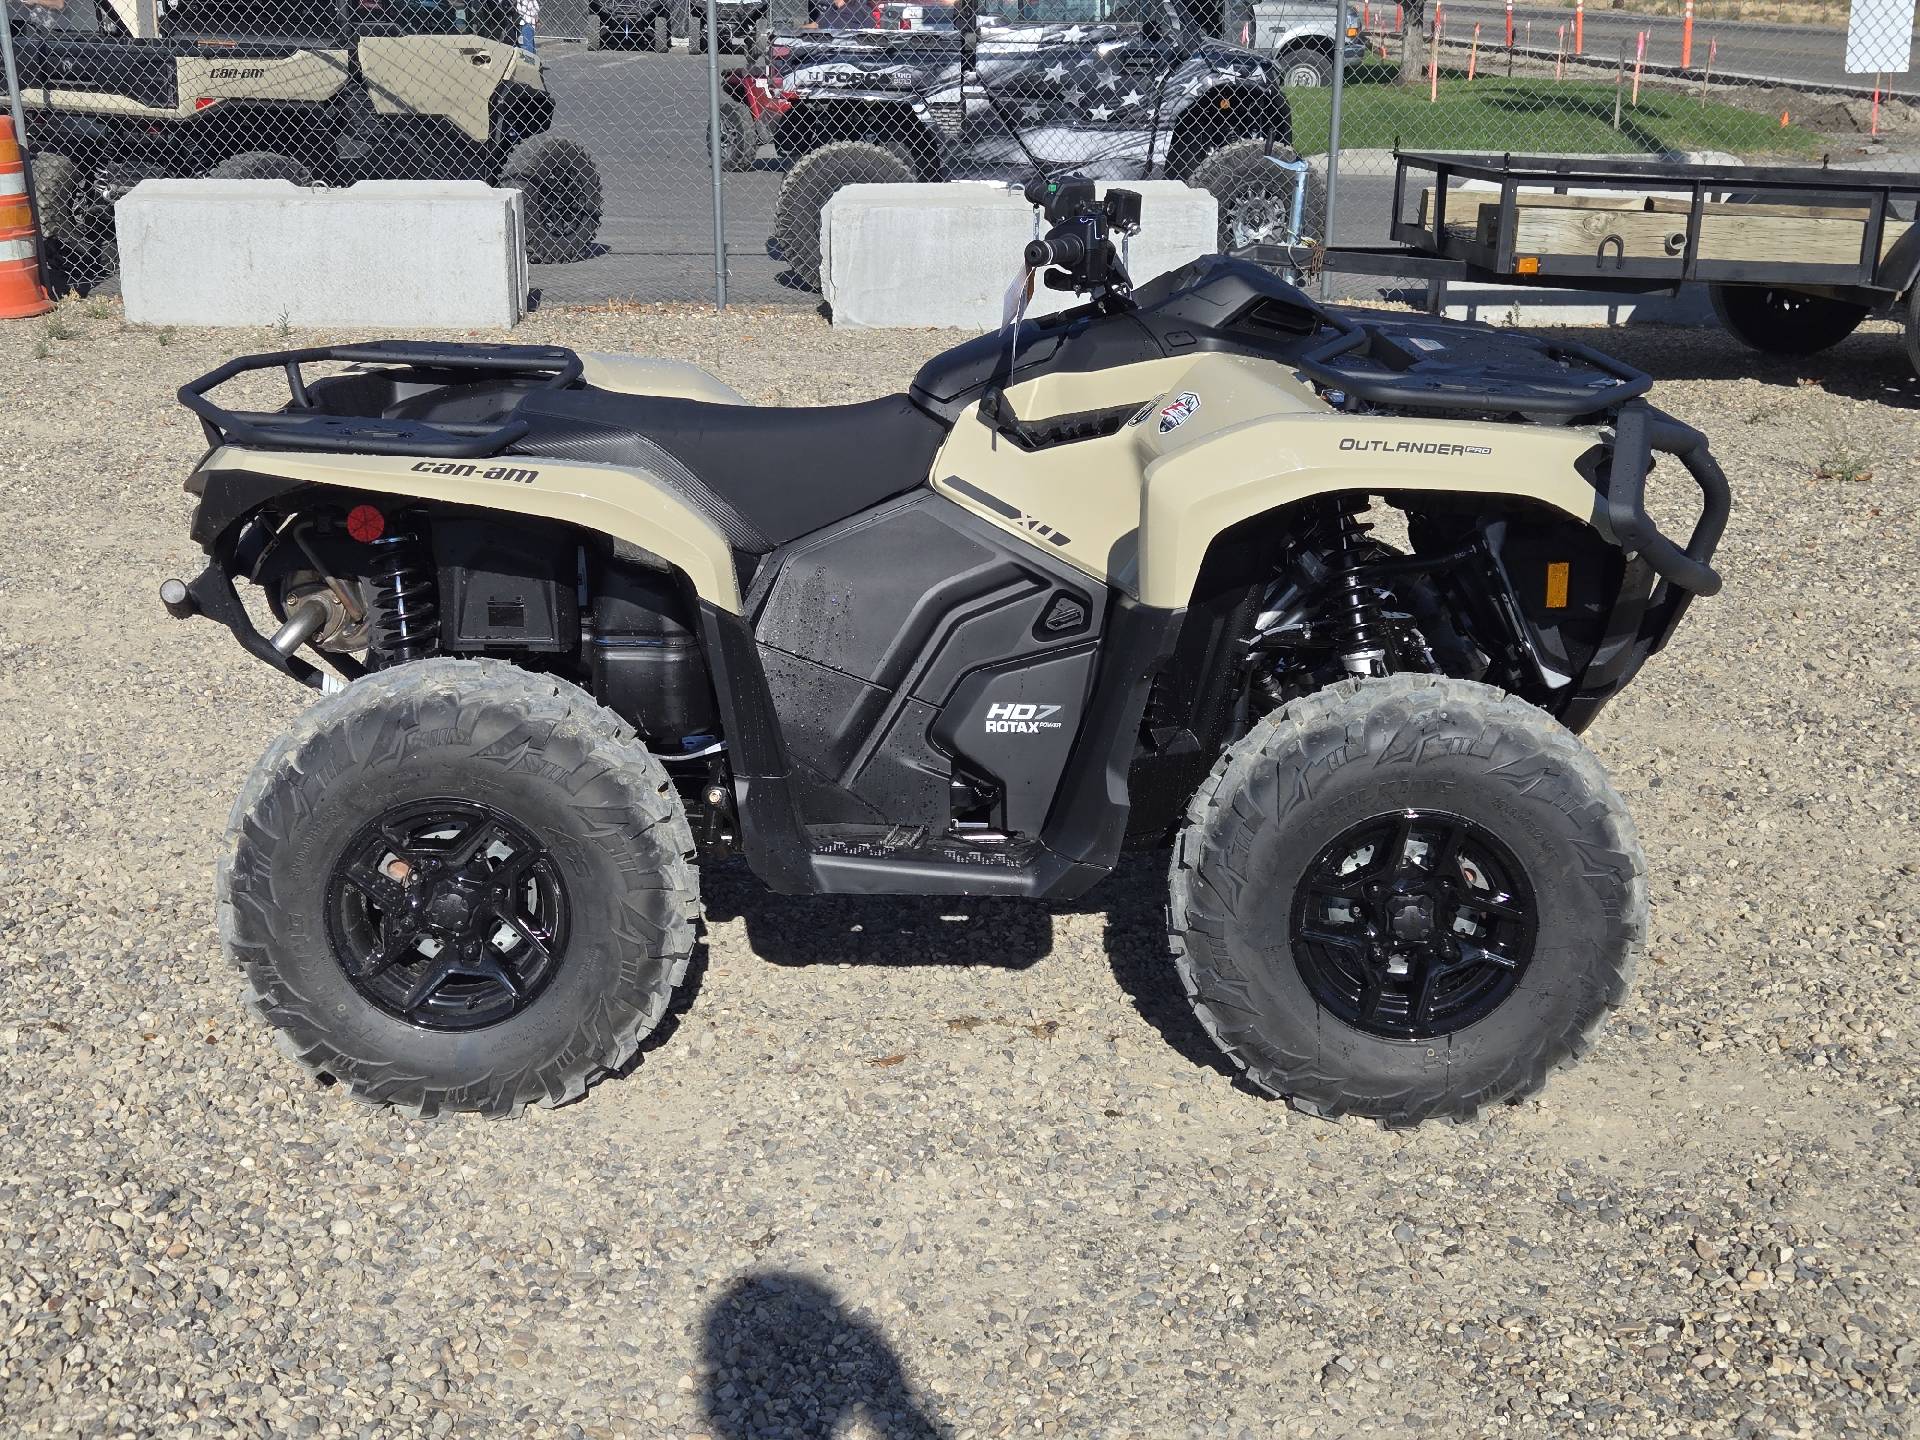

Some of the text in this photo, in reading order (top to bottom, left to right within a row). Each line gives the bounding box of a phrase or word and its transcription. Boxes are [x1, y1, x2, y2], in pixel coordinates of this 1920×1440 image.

[410, 461, 540, 484] can-am
[986, 703, 1062, 720] HD7
[985, 720, 1040, 733] ROTAX
